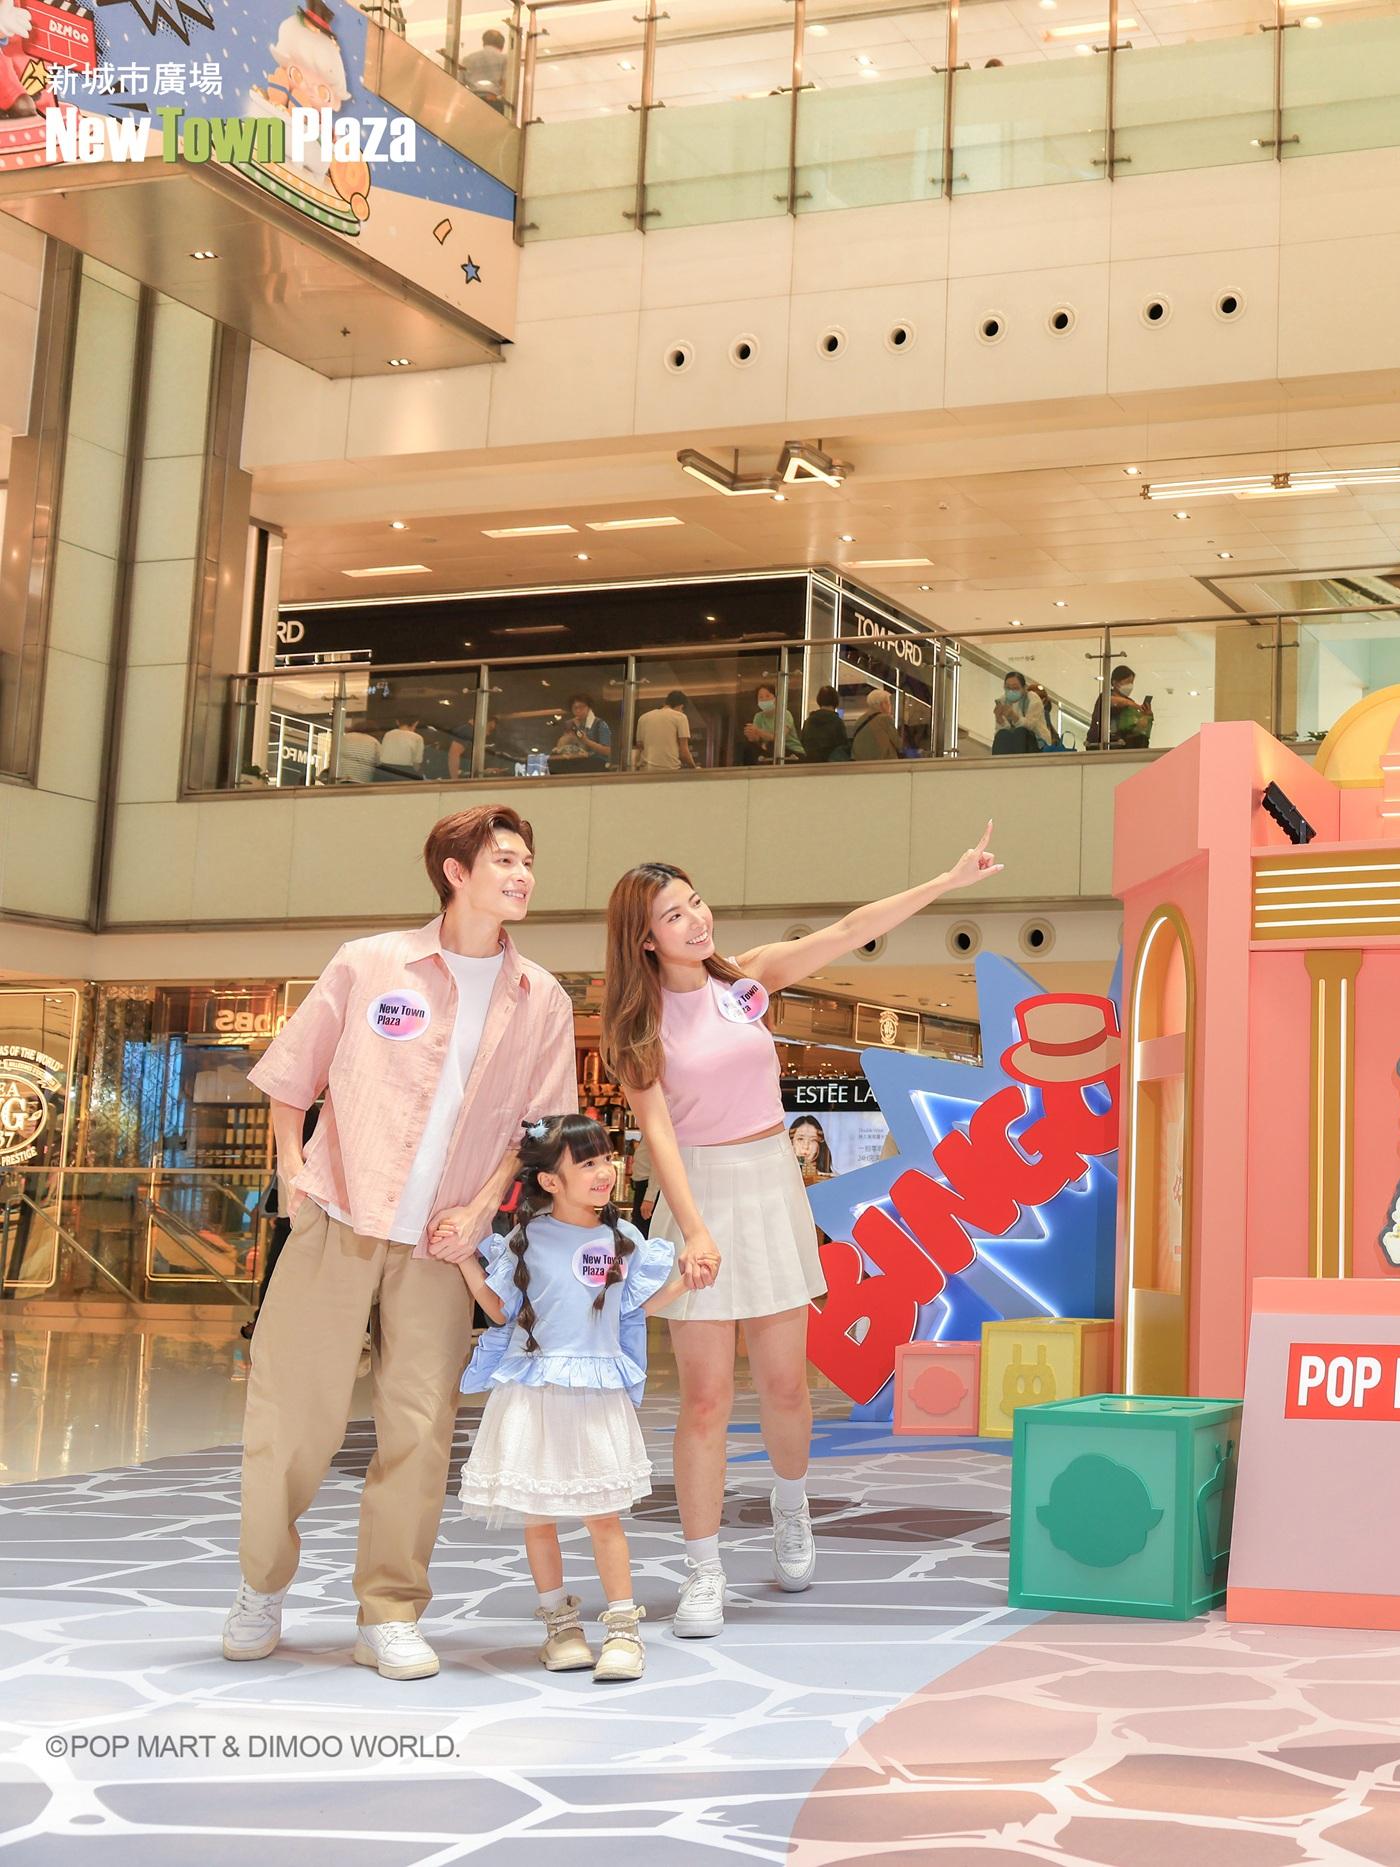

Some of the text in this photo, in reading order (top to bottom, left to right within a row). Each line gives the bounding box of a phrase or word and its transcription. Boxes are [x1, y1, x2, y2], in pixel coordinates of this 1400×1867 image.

[276, 620, 305, 644] RD
[855, 612, 922, 667] TOM FORD
[379, 1003, 425, 1018] New Town
[377, 1015, 401, 1026] Plaza
[854, 1085, 878, 1103] LA
[582, 1254, 602, 1265] New
[582, 1265, 605, 1276] Plaza
[1298, 1356, 1382, 1408] POP
